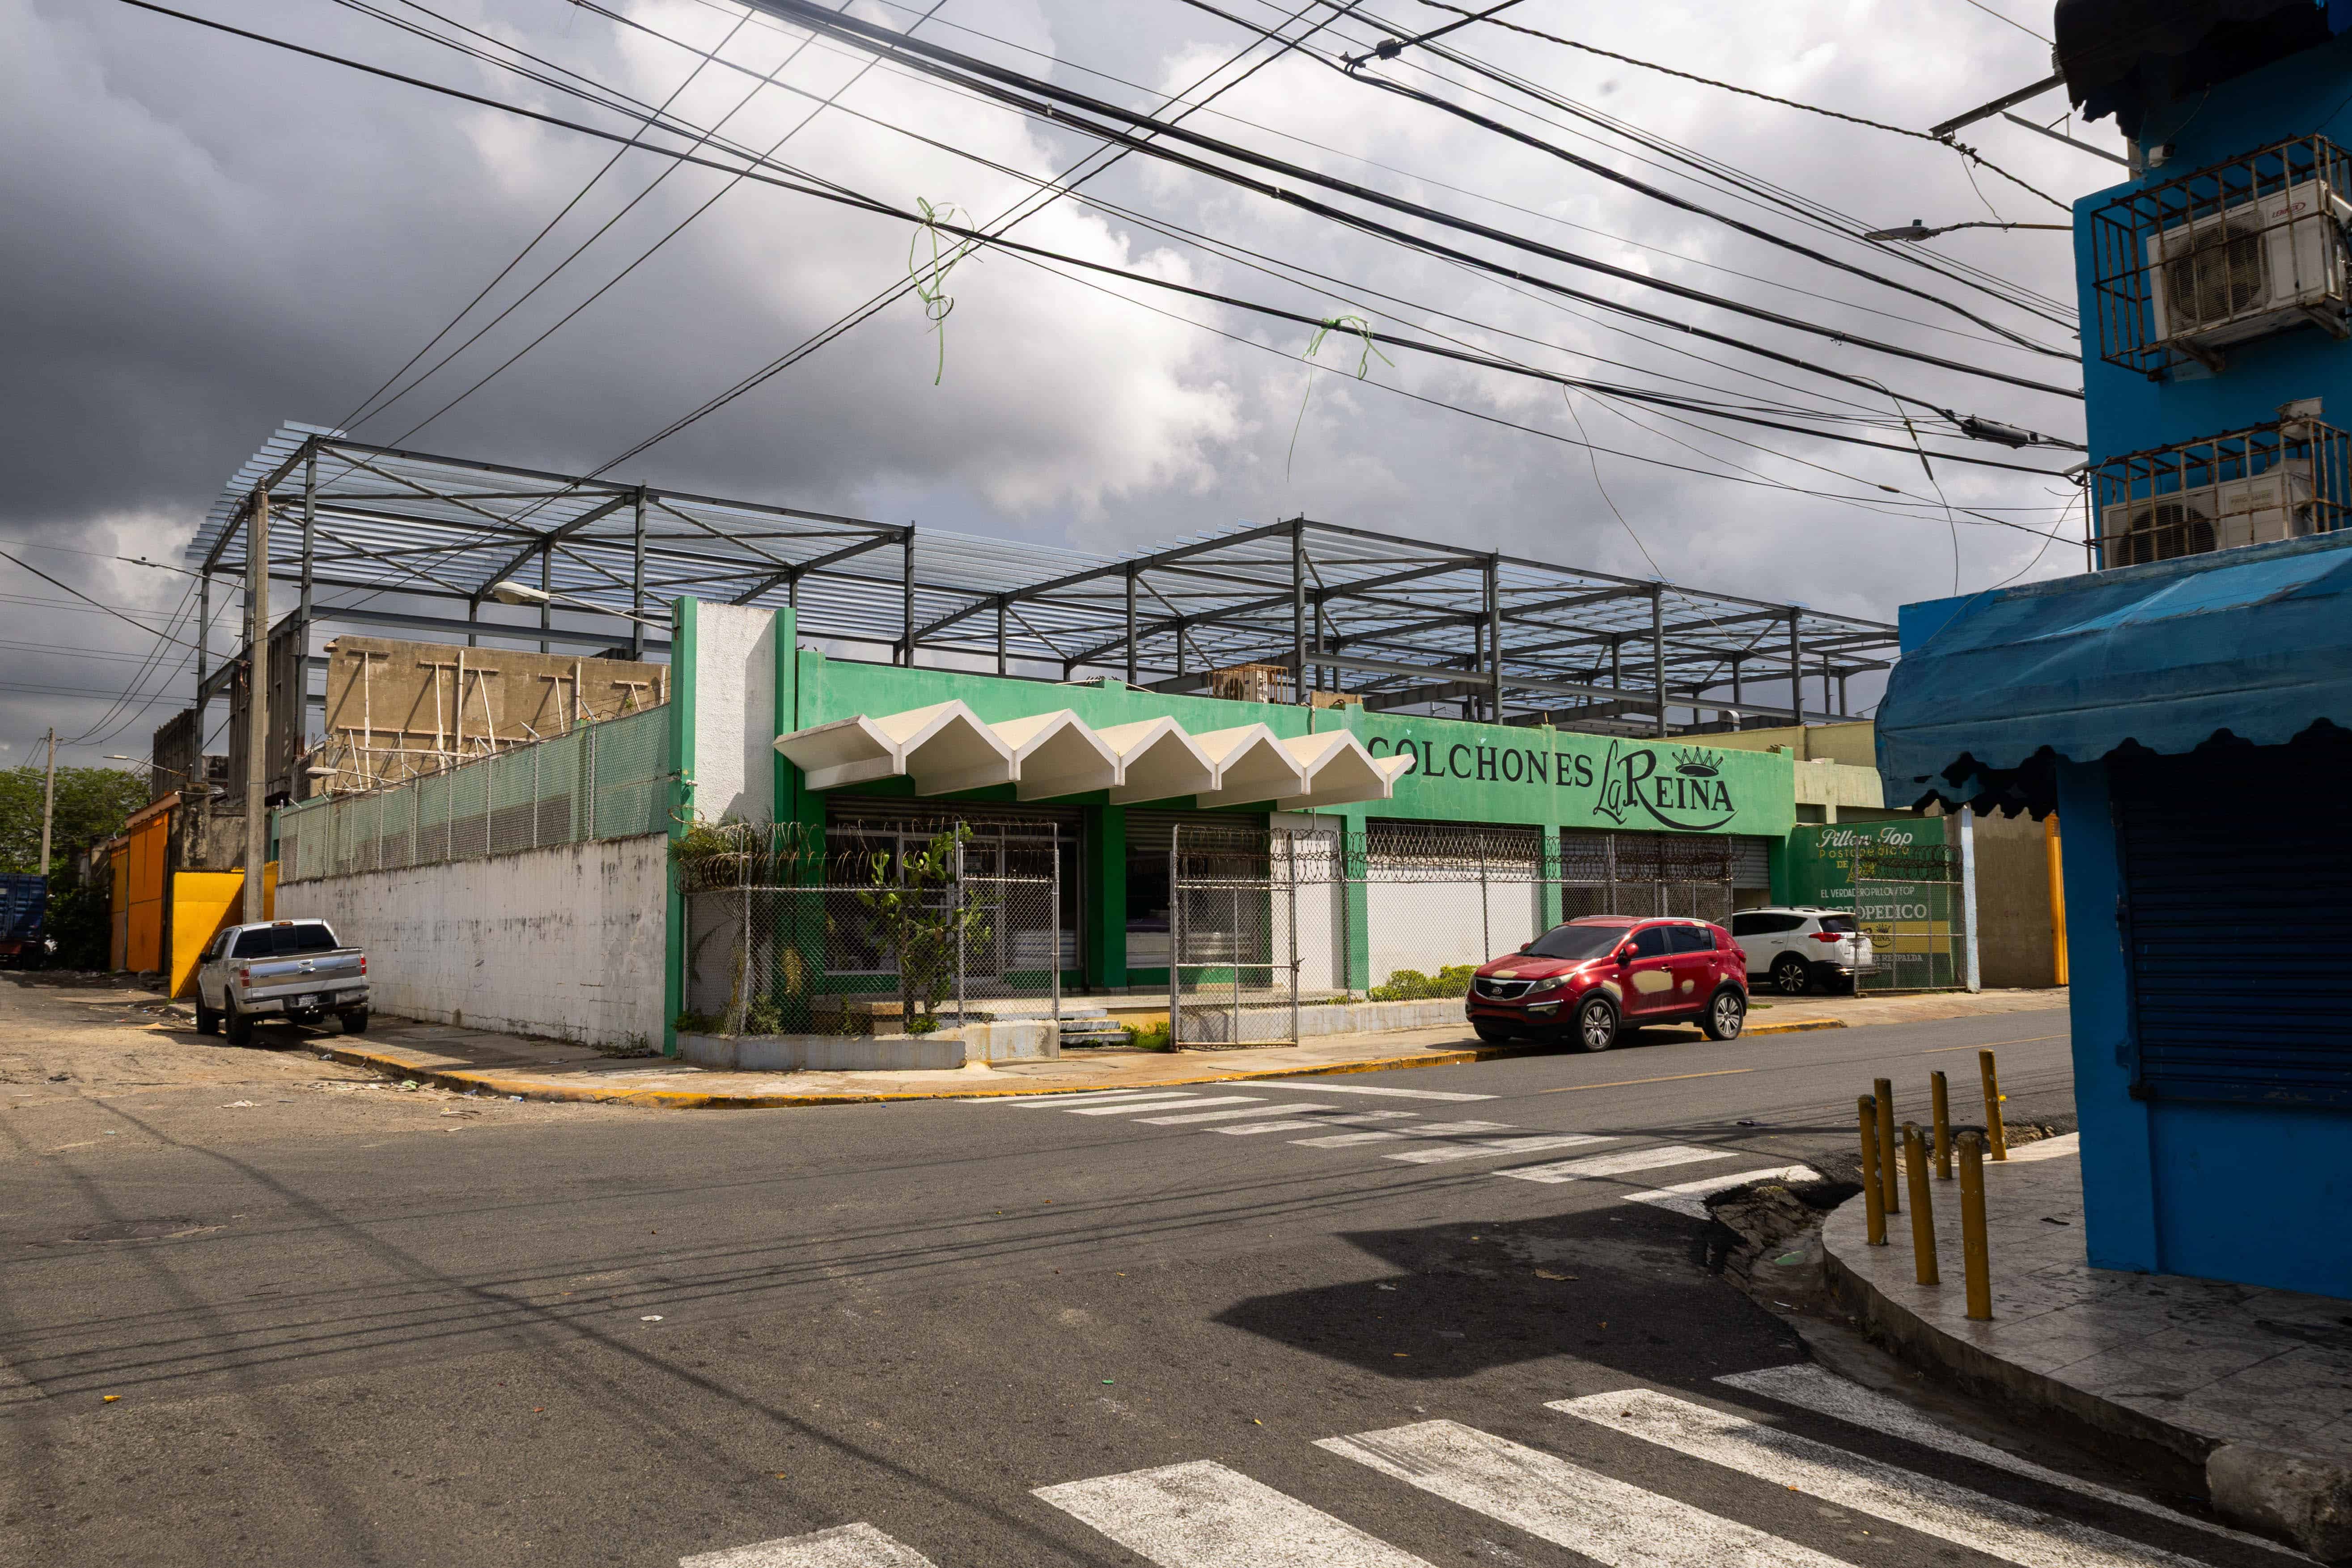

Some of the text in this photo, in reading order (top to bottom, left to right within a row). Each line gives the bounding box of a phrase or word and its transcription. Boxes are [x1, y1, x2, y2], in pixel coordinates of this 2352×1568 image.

[1367, 737, 1593, 788] COLCHONES
[1593, 739, 1627, 825] La
[1877, 827, 1913, 848] Top
[1836, 860, 1848, 869] DE
[1821, 889, 1829, 898] EL
[1831, 888, 1869, 898] VERDADRO
[1899, 886, 1915, 895] TOP
[1882, 954, 1923, 962] REPALDA
